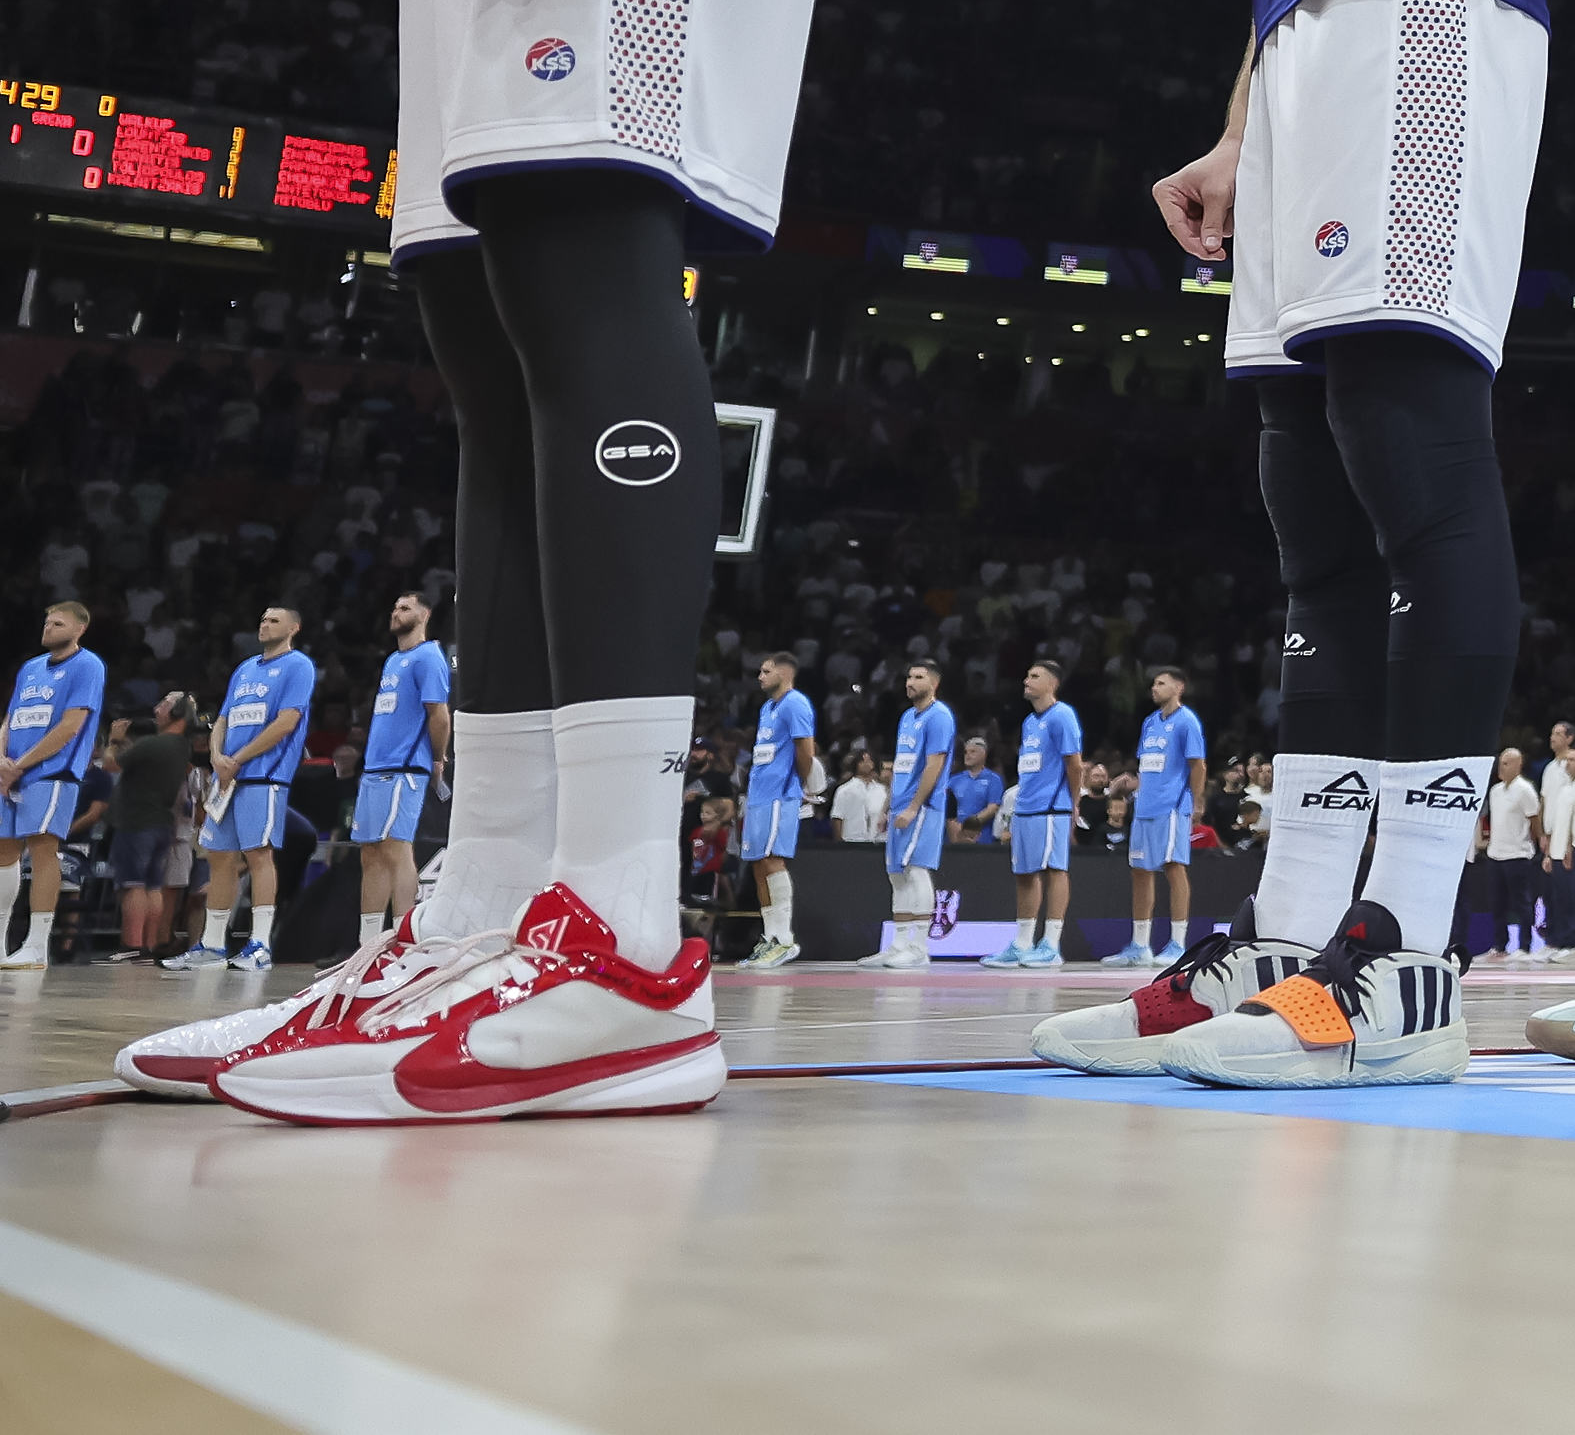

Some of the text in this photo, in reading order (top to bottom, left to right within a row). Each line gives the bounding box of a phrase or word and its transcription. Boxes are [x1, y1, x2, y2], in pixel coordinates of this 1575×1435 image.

[532, 57, 571, 71] KSS
[1320, 236, 1345, 249] KSS
[602, 445, 673, 460] GSA
[1301, 794, 1373, 812] PEAK
[1405, 791, 1481, 813] PEAK
